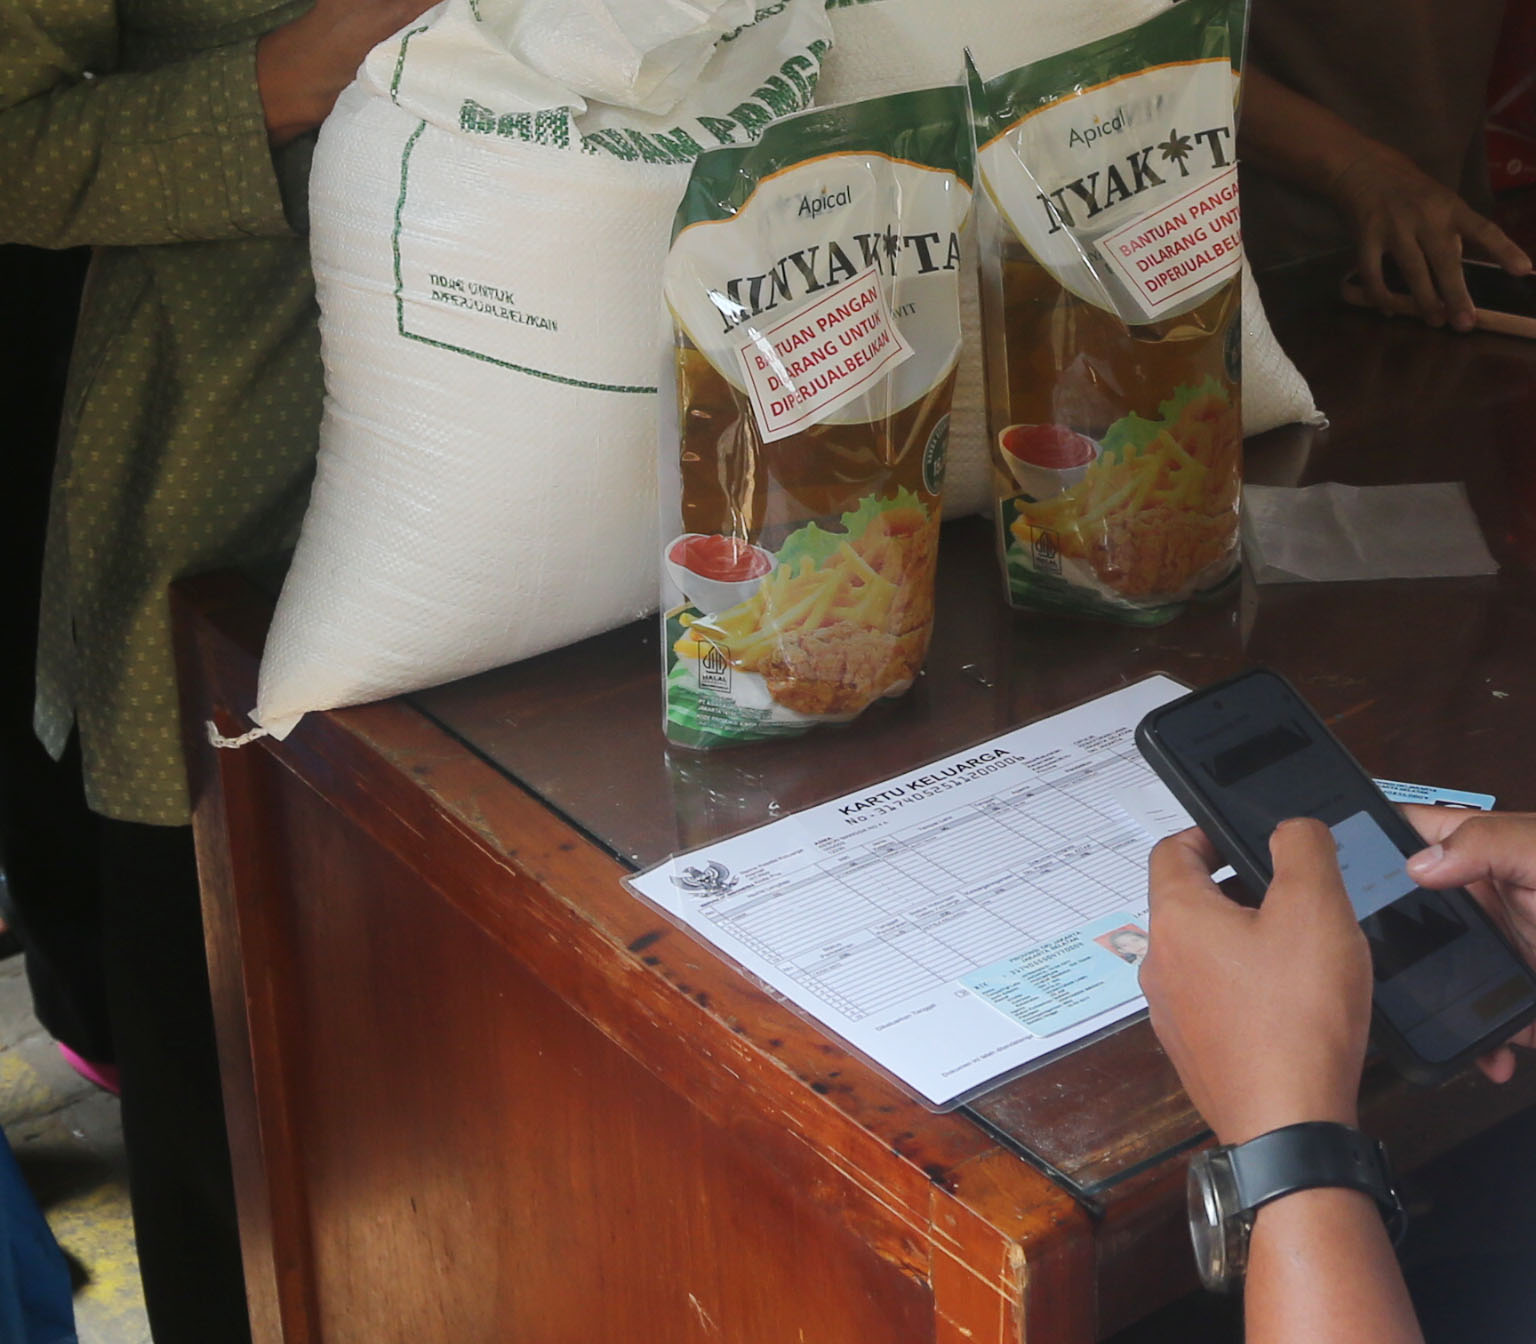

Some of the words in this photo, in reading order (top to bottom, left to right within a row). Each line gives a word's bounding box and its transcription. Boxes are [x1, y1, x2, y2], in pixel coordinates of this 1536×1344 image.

[1068, 108, 1126, 148] Apical
[798, 185, 851, 218] Apical
[1119, 213, 1188, 257] BANTUAN
[1189, 183, 1239, 219] PANGA
[1136, 228, 1207, 272] DILARANG
[1209, 207, 1241, 233] UNT
[1145, 233, 1241, 293] DIPERJUALBEL
[468, 282, 514, 304] UNTUK
[755, 326, 816, 370] BTUAN
[817, 286, 878, 332] PANGAN
[838, 310, 882, 347] UNTUK
[770, 332, 890, 417] DIPERJUALBELIKAN
[838, 786, 904, 817] KARTU
[909, 748, 1011, 791] KELUARGA
